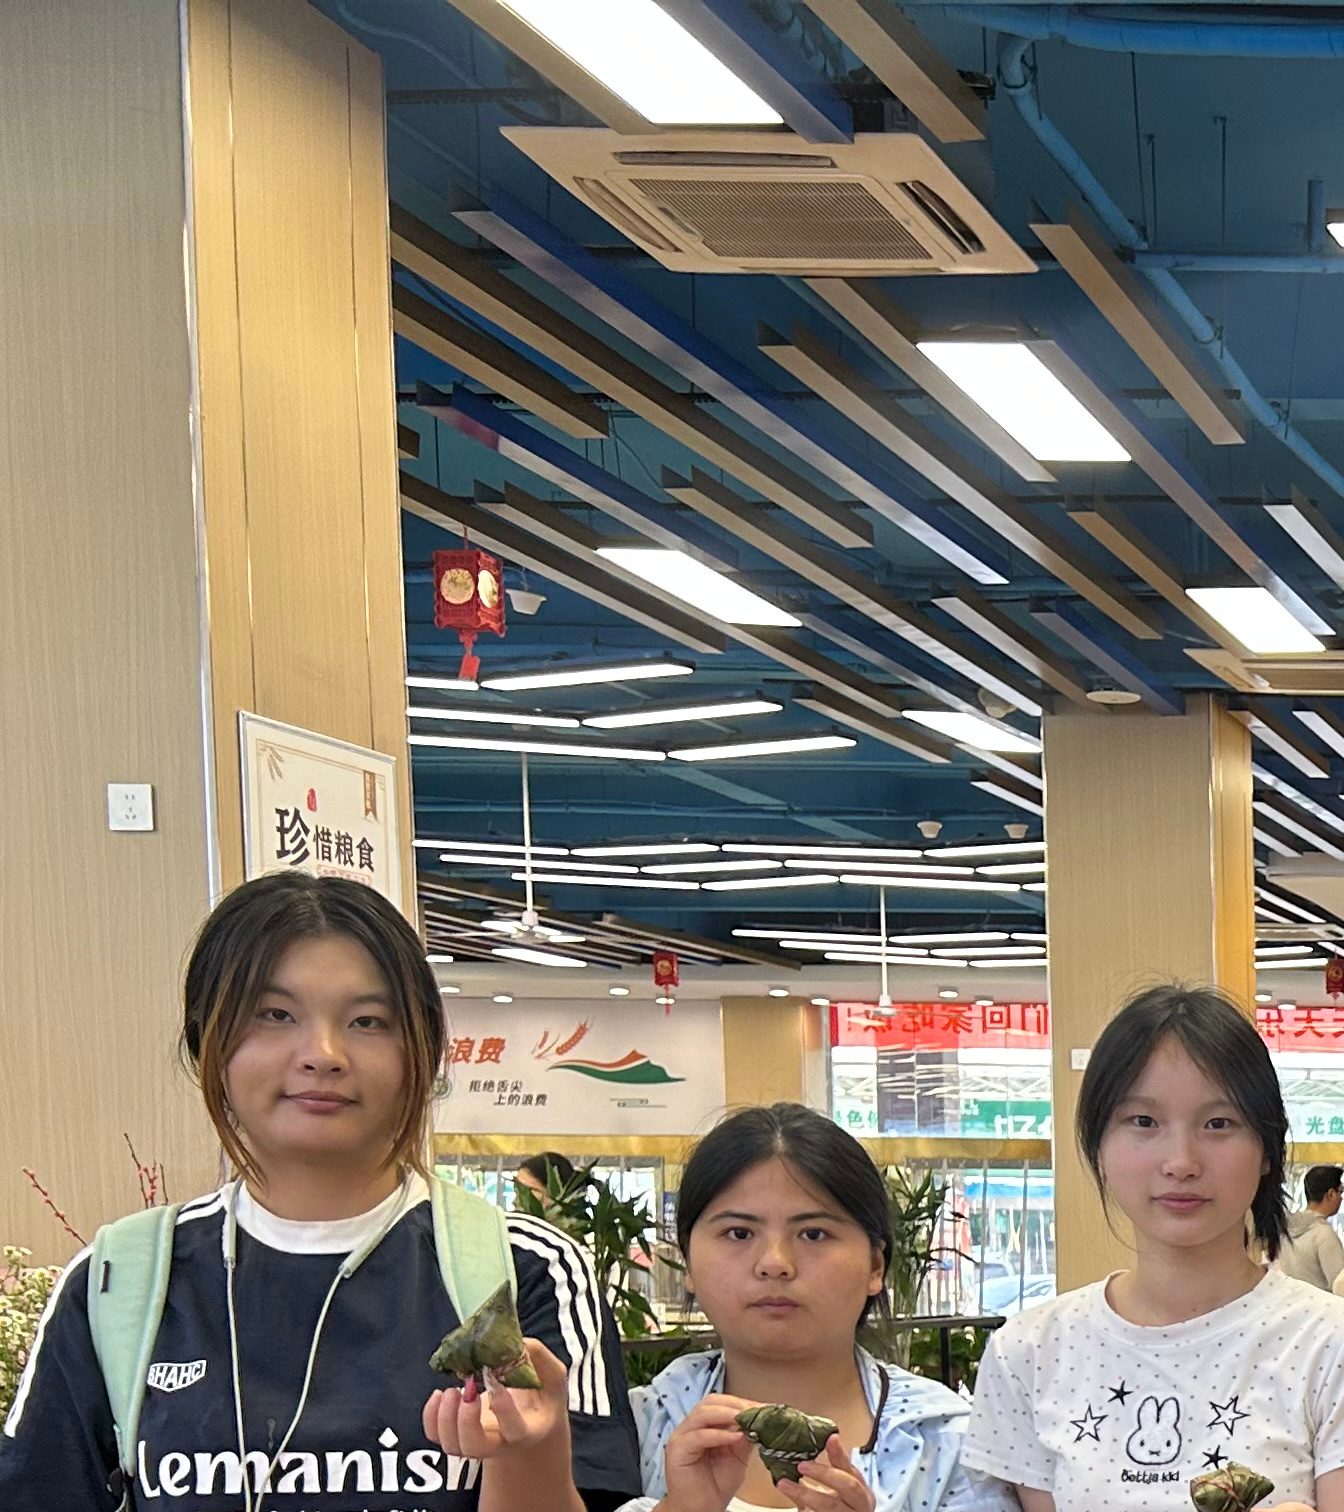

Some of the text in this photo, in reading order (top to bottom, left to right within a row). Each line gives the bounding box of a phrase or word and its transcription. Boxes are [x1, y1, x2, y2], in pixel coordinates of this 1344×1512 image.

[275, 807, 374, 872] 珍惜粮食
[449, 1037, 506, 1064] 浪费
[469, 1079, 523, 1093] 拒绝舌尖
[493, 1093, 547, 1106] 上的浪费
